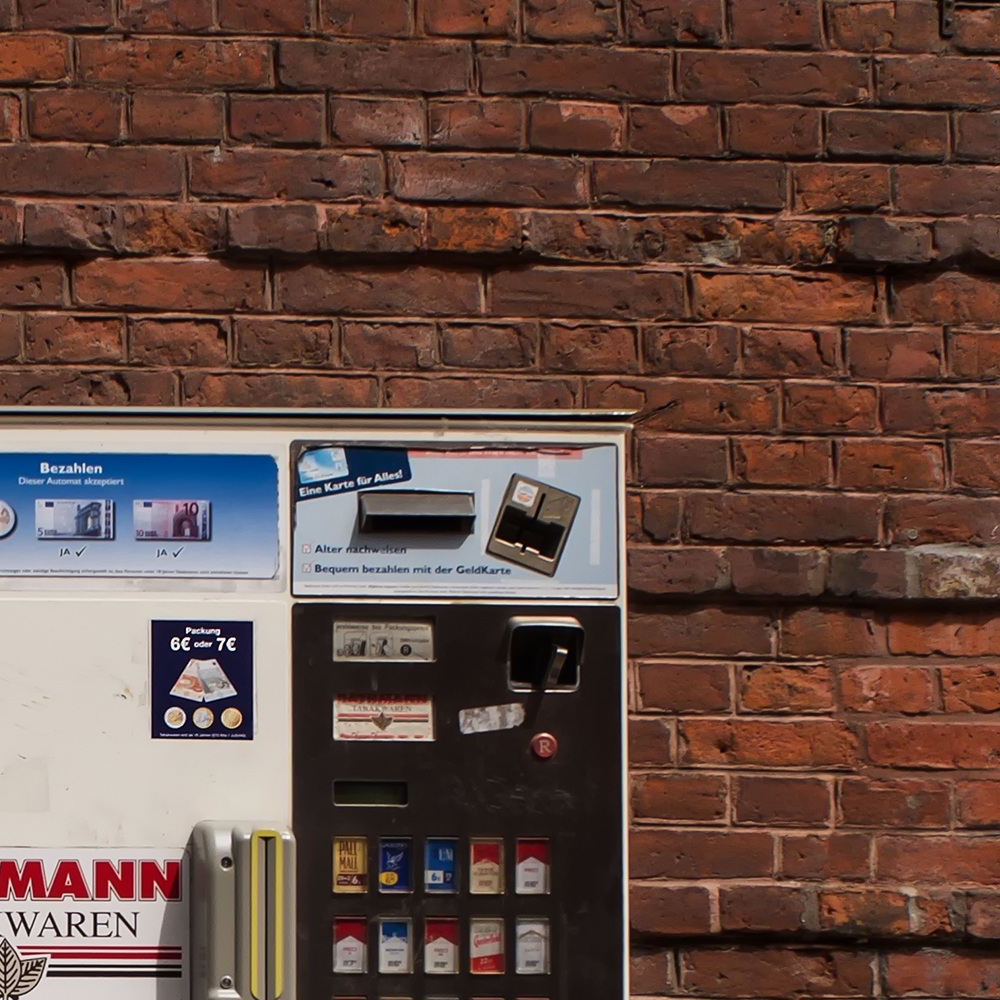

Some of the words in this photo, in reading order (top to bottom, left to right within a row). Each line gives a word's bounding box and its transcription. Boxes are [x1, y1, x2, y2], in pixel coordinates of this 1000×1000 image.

[40, 462, 103, 474] Bezahlen
[18, 476, 44, 485] Dieser
[46, 476, 81, 485] Automat
[299, 486, 322, 497] Eine
[324, 480, 355, 493] Karte
[356, 476, 372, 486] für
[373, 469, 403, 483] Alles!
[59, 548, 71, 557] JA
[156, 549, 167, 558] JA
[314, 544, 342, 554] Alter
[346, 545, 407, 555] nachweisen
[314, 564, 359, 575] Bequem
[362, 565, 410, 574] bezahlen
[412, 565, 431, 574] mit
[434, 565, 453, 574] der
[456, 566, 512, 575] GeldKarte
[185, 627, 221, 636] Packung
[170, 637, 191, 651] 6€
[216, 637, 237, 651] 7€
[539, 740, 552, 754] R
